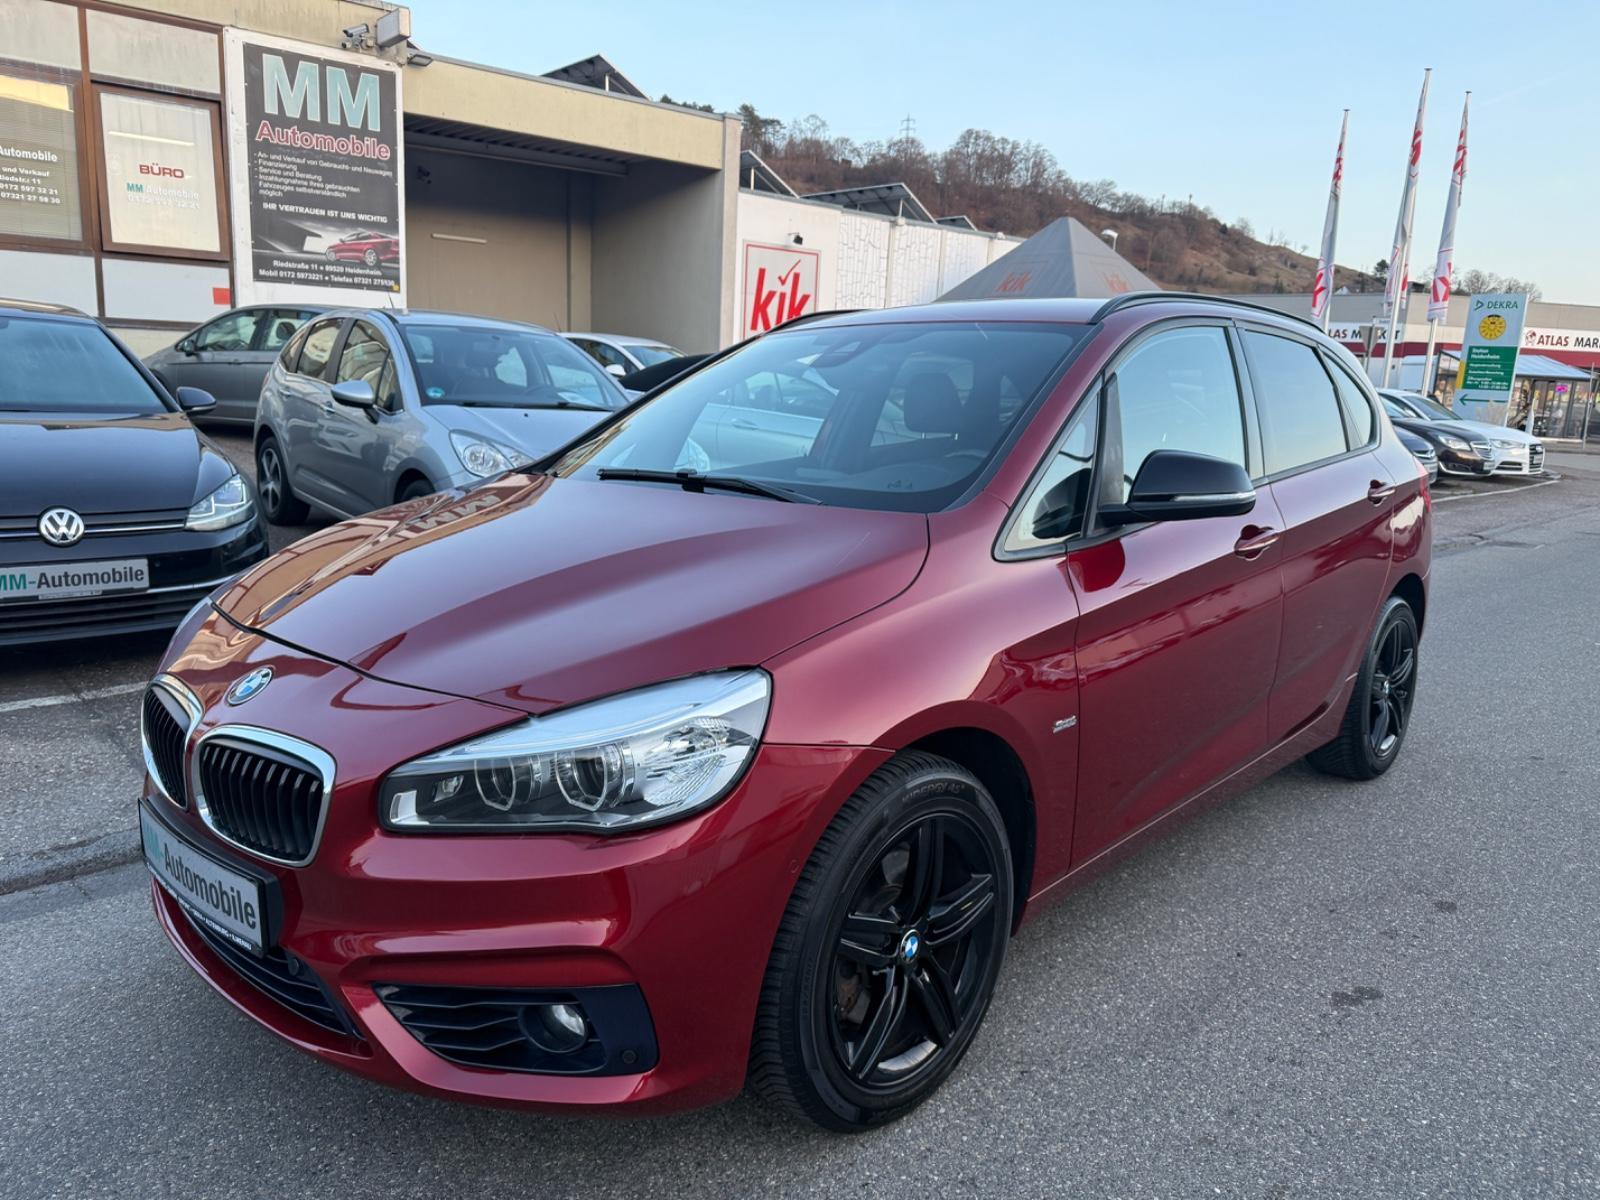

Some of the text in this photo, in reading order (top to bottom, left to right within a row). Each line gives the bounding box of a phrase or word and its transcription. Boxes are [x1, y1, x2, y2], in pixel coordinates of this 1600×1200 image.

[262, 53, 380, 132] MM
[256, 119, 391, 160] Automobile
[259, 159, 298, 171] Finanzierung
[283, 155, 306, 164] Verkauf
[139, 162, 185, 179] BÜRO
[126, 182, 144, 193] MM
[278, 204, 326, 216] VERTRAUEN
[327, 210, 339, 218] IST
[341, 211, 356, 219] UNS
[357, 214, 388, 223] WICHTIG
[259, 269, 278, 277] Mobil
[1487, 301, 1519, 309] DEKRA
[1536, 334, 1600, 349] ATLAS MAR
[164, 842, 257, 930] Automobile
